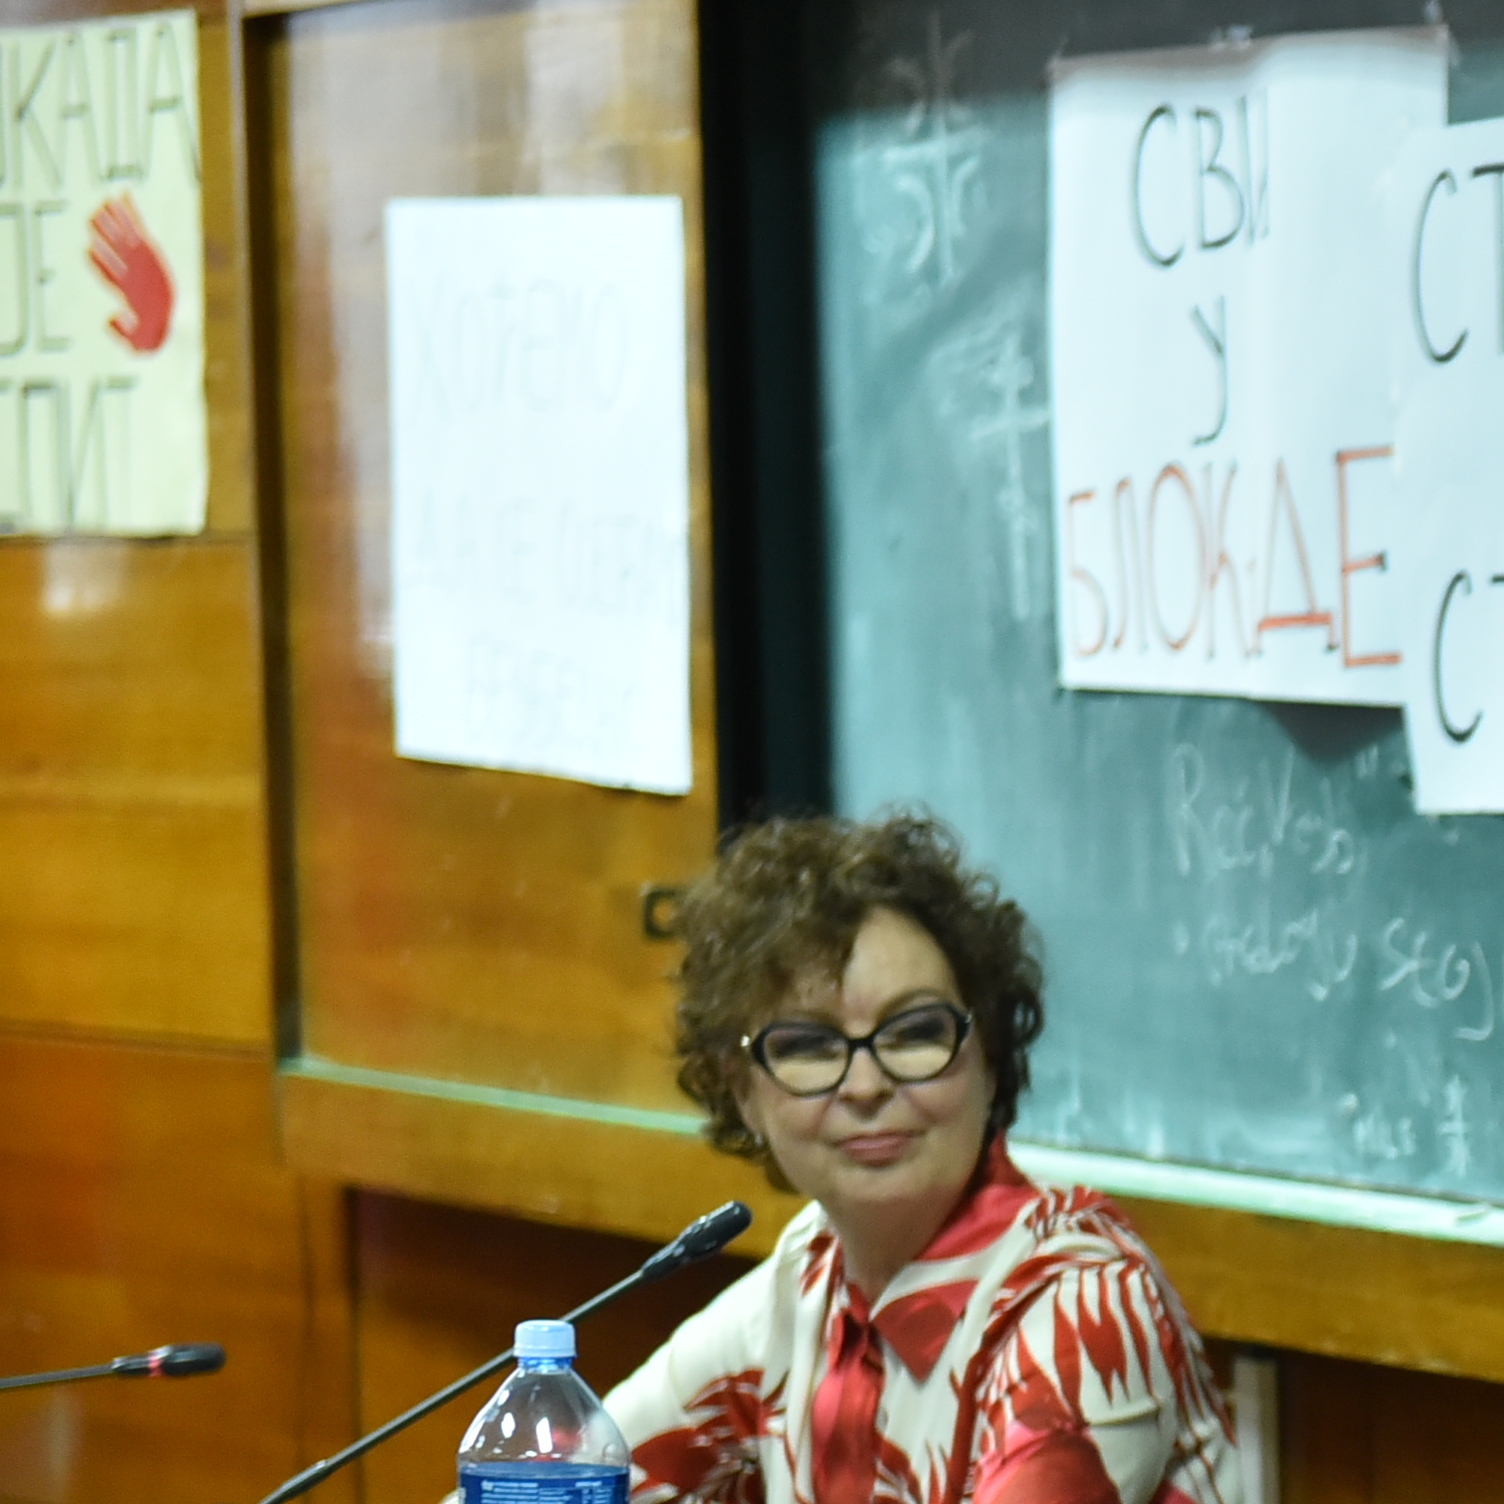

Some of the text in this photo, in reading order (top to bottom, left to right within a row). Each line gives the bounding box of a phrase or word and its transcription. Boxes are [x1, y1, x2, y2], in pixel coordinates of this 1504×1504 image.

[0, 20, 200, 187] КАДА
[1132, 88, 1271, 268] СВИ
[1067, 443, 1404, 668] БЛОКДЕ
